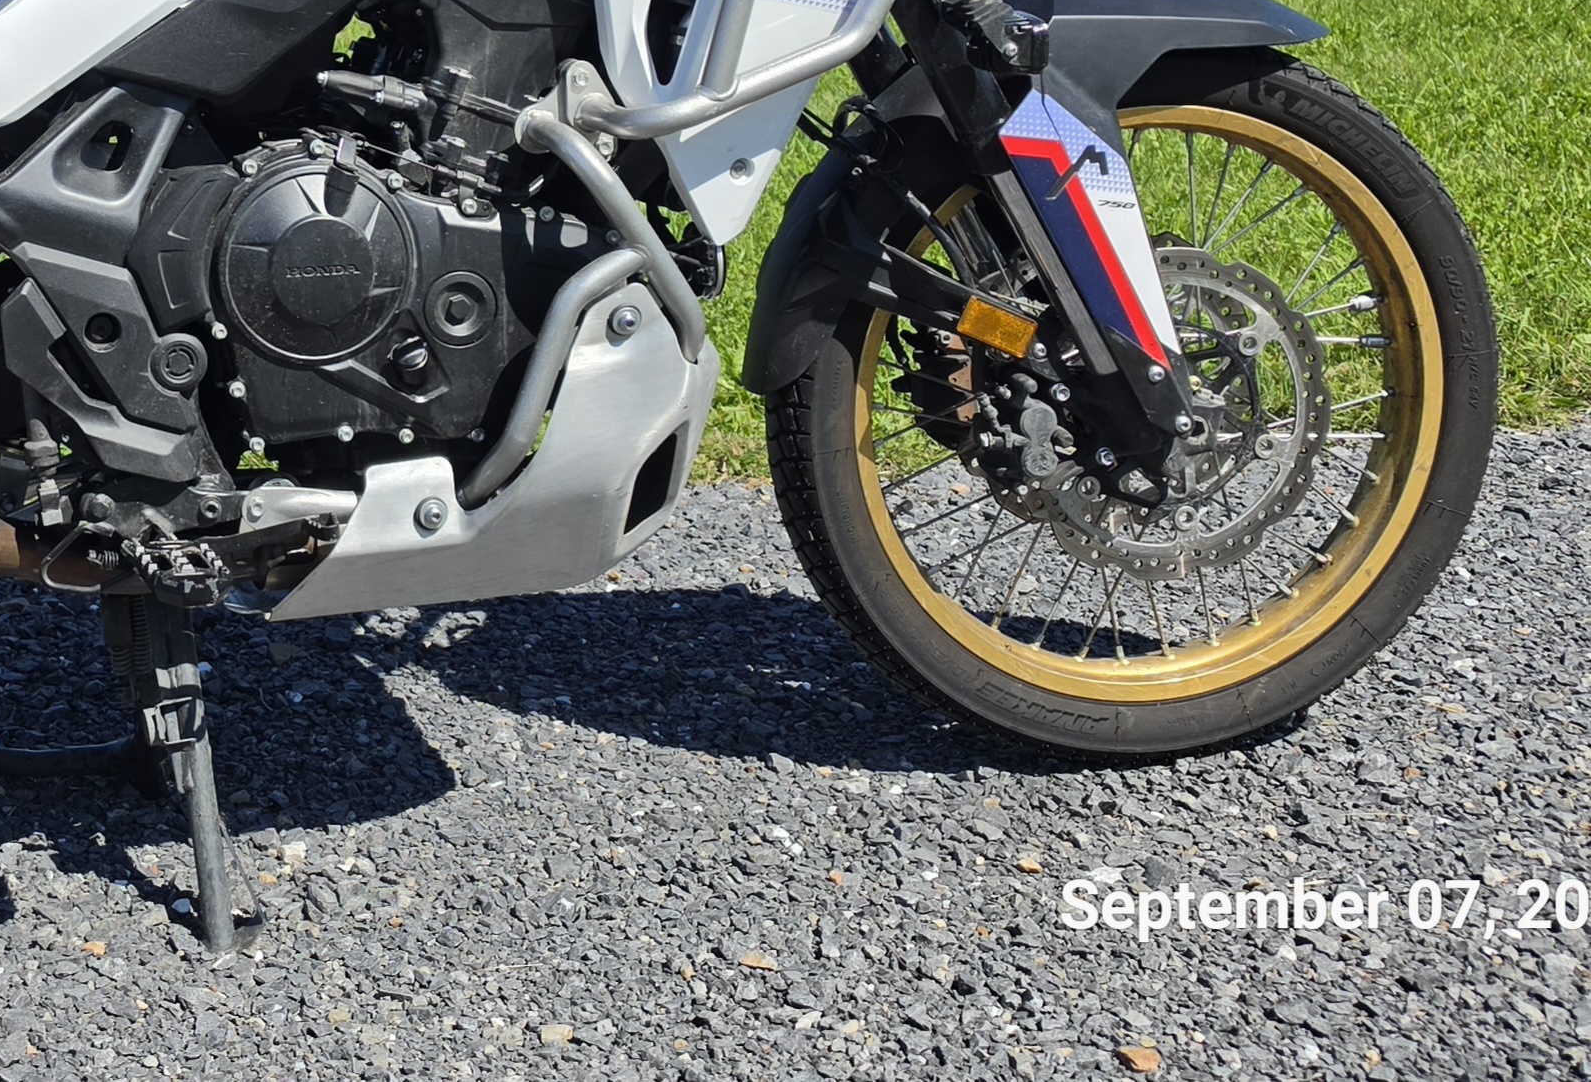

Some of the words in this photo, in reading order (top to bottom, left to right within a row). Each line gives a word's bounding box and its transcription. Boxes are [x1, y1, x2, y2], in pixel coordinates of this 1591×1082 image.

[1288, 98, 1416, 194] MICHELIN
[1097, 199, 1136, 209] 750
[285, 263, 361, 278] HONDA
